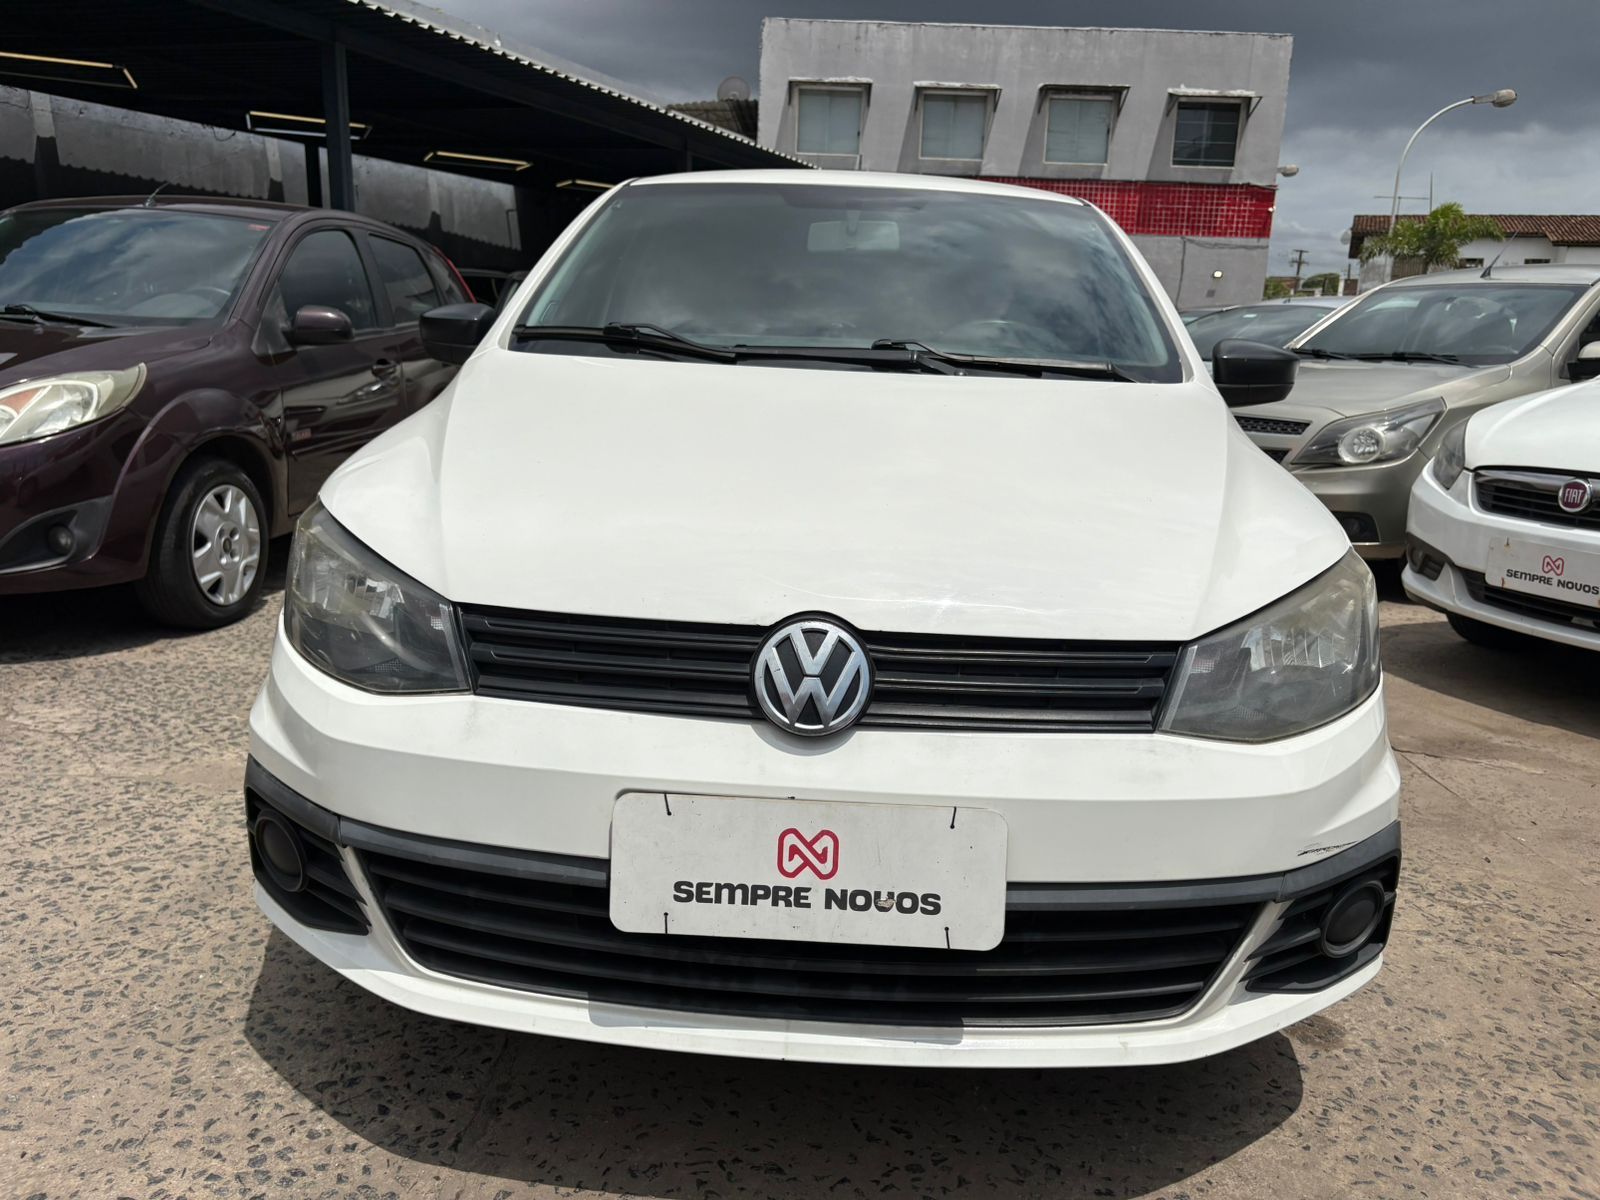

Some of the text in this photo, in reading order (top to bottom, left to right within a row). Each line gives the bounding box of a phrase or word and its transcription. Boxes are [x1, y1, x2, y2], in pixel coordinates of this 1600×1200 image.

[1564, 488, 1583, 504] FIAT
[757, 621, 868, 733] VW
[672, 880, 812, 909] SEMPRE
